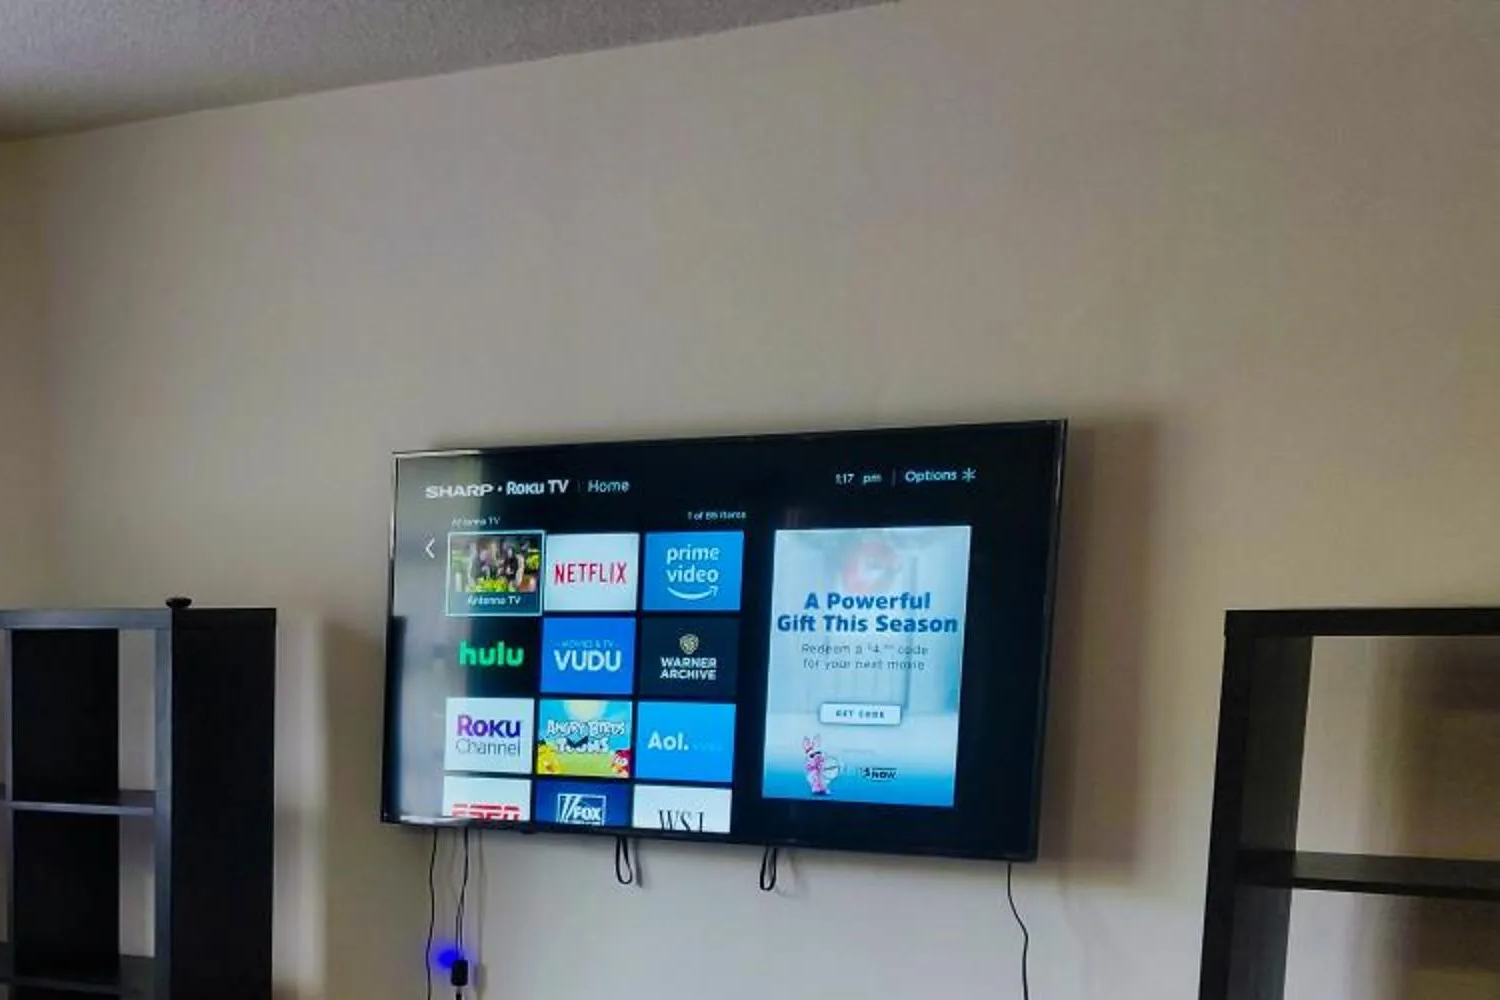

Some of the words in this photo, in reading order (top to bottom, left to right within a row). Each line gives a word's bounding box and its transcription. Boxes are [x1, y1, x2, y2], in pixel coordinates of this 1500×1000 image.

[862, 474, 882, 486] pm
[904, 469, 957, 484] Options
[425, 485, 494, 498] SHARP
[547, 480, 569, 493] TV
[588, 480, 630, 493] Home
[666, 545, 721, 563] prime
[553, 562, 628, 585] NETFLIX
[666, 564, 719, 583] video
[508, 596, 522, 605] TV
[804, 592, 820, 610] A
[827, 592, 932, 610] Powerful
[777, 614, 816, 632] Gift
[824, 614, 869, 632] This
[875, 615, 959, 633] Season
[459, 641, 524, 667] hulu
[802, 643, 851, 655] Redeem
[553, 649, 623, 672] VUDU
[660, 656, 717, 669] WARNER
[803, 658, 820, 669] for
[826, 660, 851, 671] your
[855, 659, 883, 669] next
[887, 660, 925, 671] movie
[660, 669, 716, 681] ARCHIVE
[455, 738, 521, 757] Channel
[647, 731, 690, 751] Aol.
[573, 807, 601, 821] FOX
